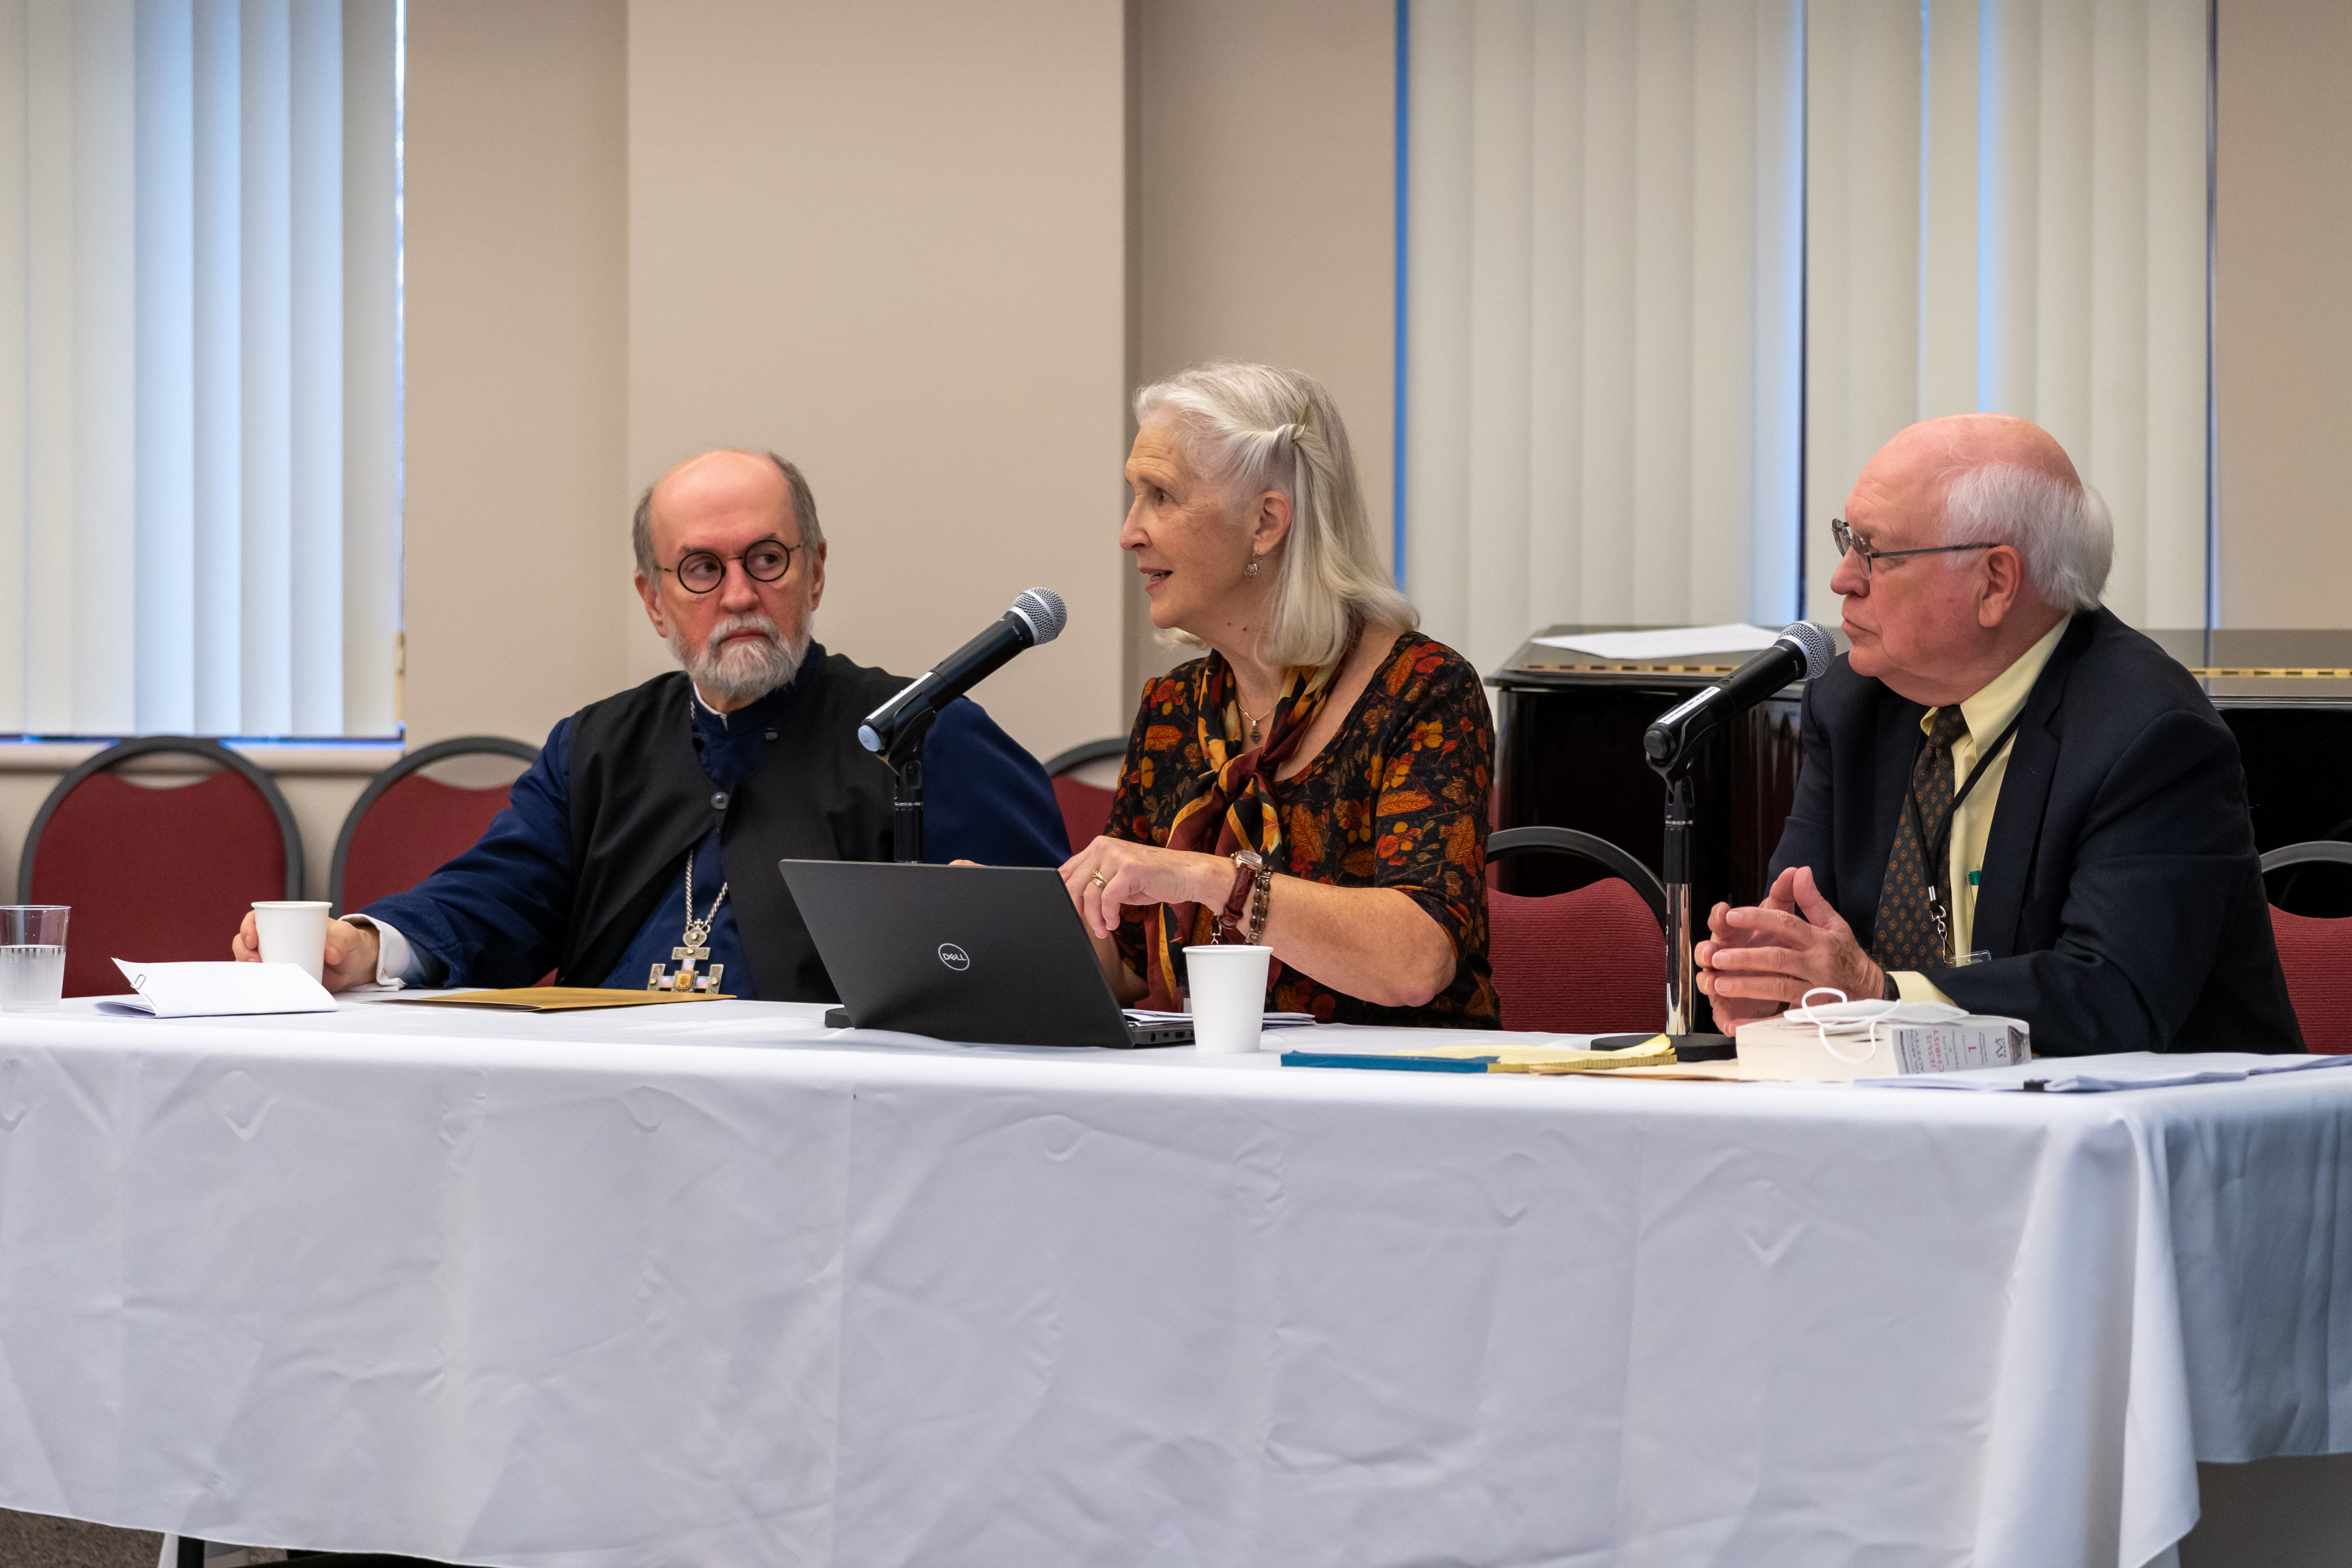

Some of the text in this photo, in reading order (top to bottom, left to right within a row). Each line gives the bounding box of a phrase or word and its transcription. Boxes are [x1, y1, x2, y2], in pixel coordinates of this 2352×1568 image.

[1915, 1029, 1924, 1073] ALFEYEV
[1926, 1034, 1937, 1068] JESUS
[1933, 1027, 1944, 1072] CHRIST
